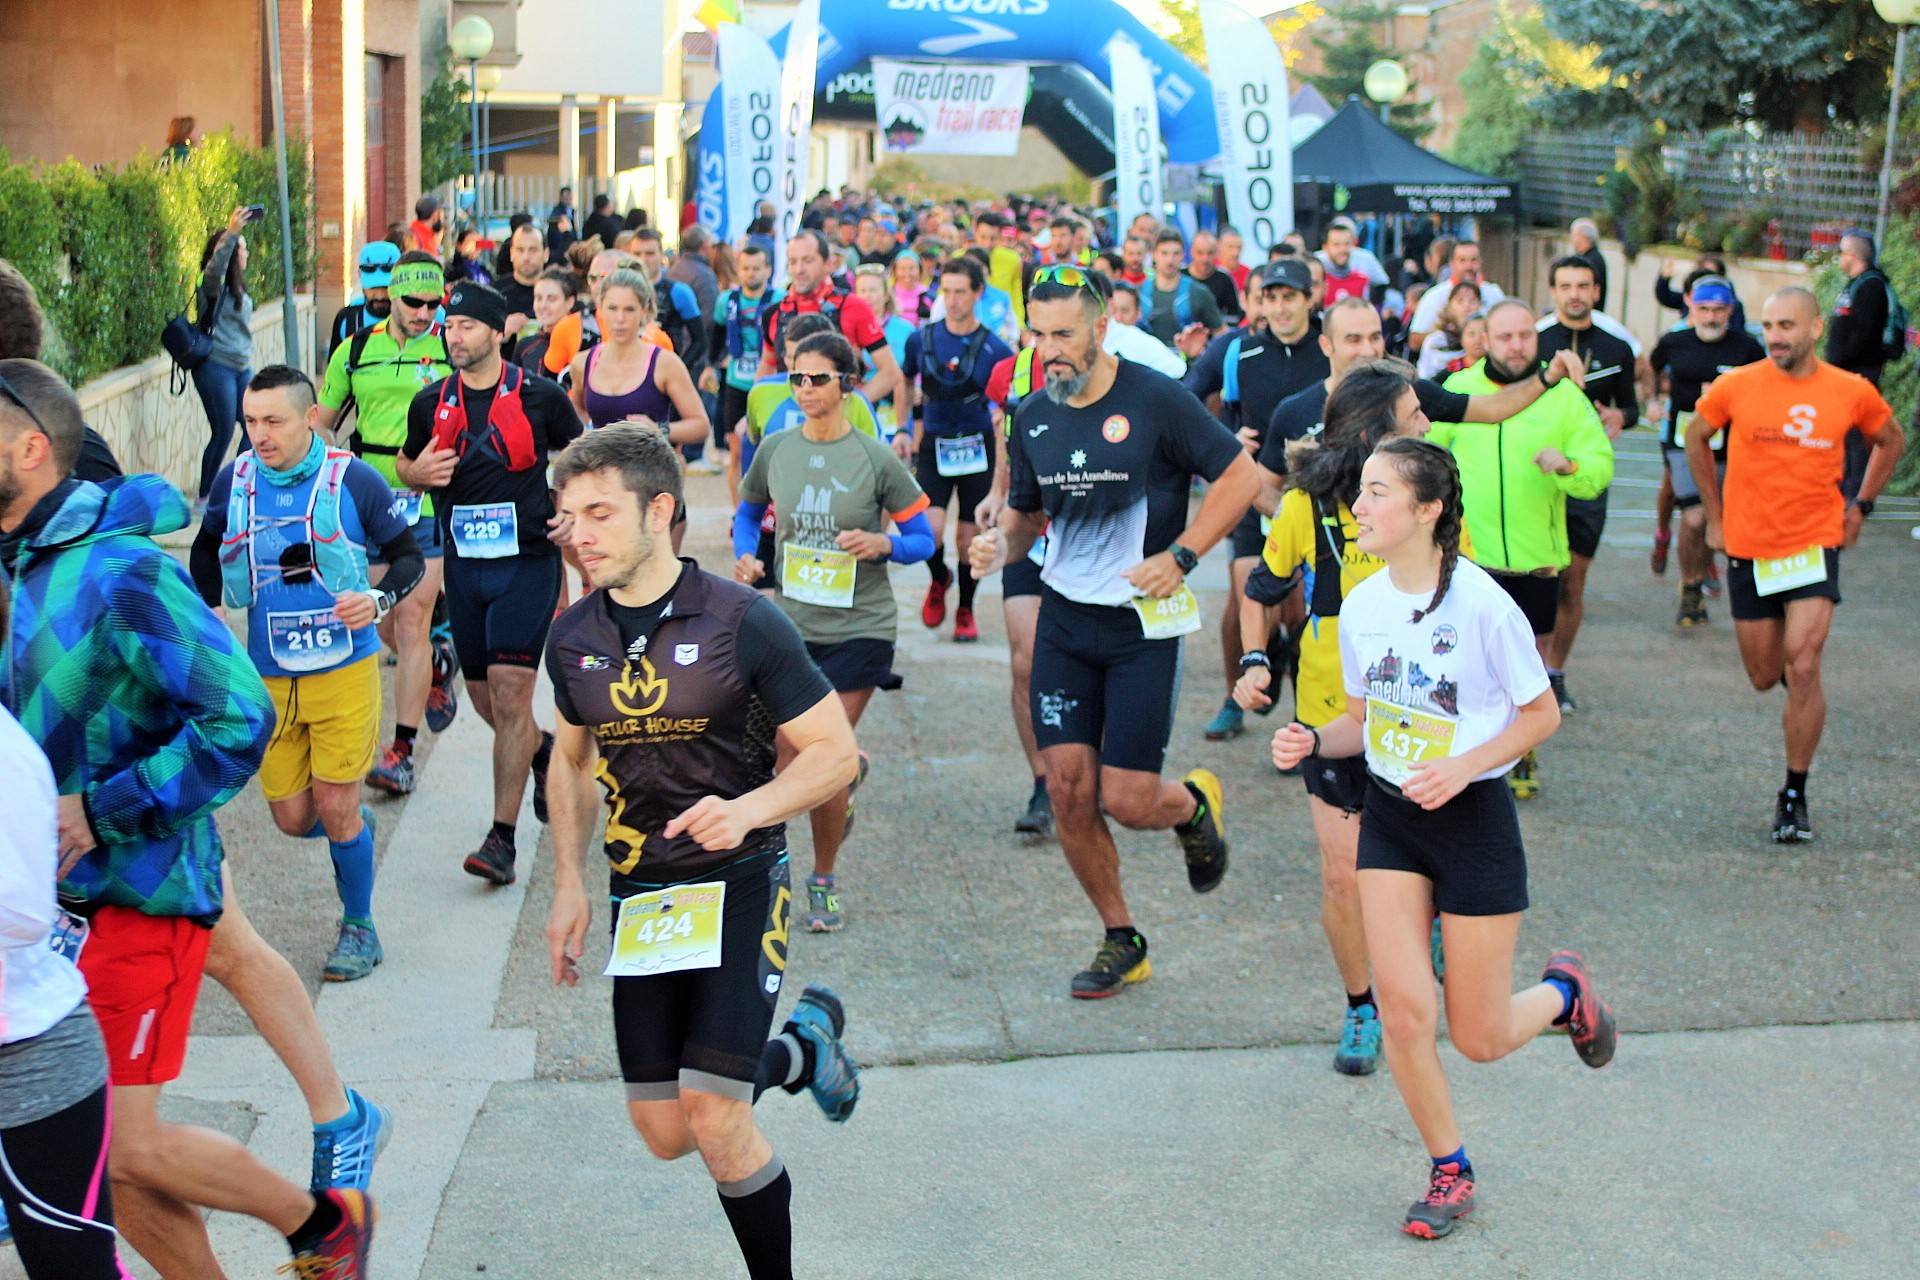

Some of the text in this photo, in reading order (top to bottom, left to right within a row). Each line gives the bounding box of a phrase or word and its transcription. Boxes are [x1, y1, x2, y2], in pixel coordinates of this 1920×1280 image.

[463, 520, 501, 540] 229
[791, 512, 839, 531] TRAIL
[797, 564, 837, 586] 427
[1155, 594, 1190, 617] 462
[287, 628, 333, 651] 216
[645, 716, 710, 734] HOUSE
[1380, 729, 1428, 762] 437
[636, 911, 694, 945] 424
